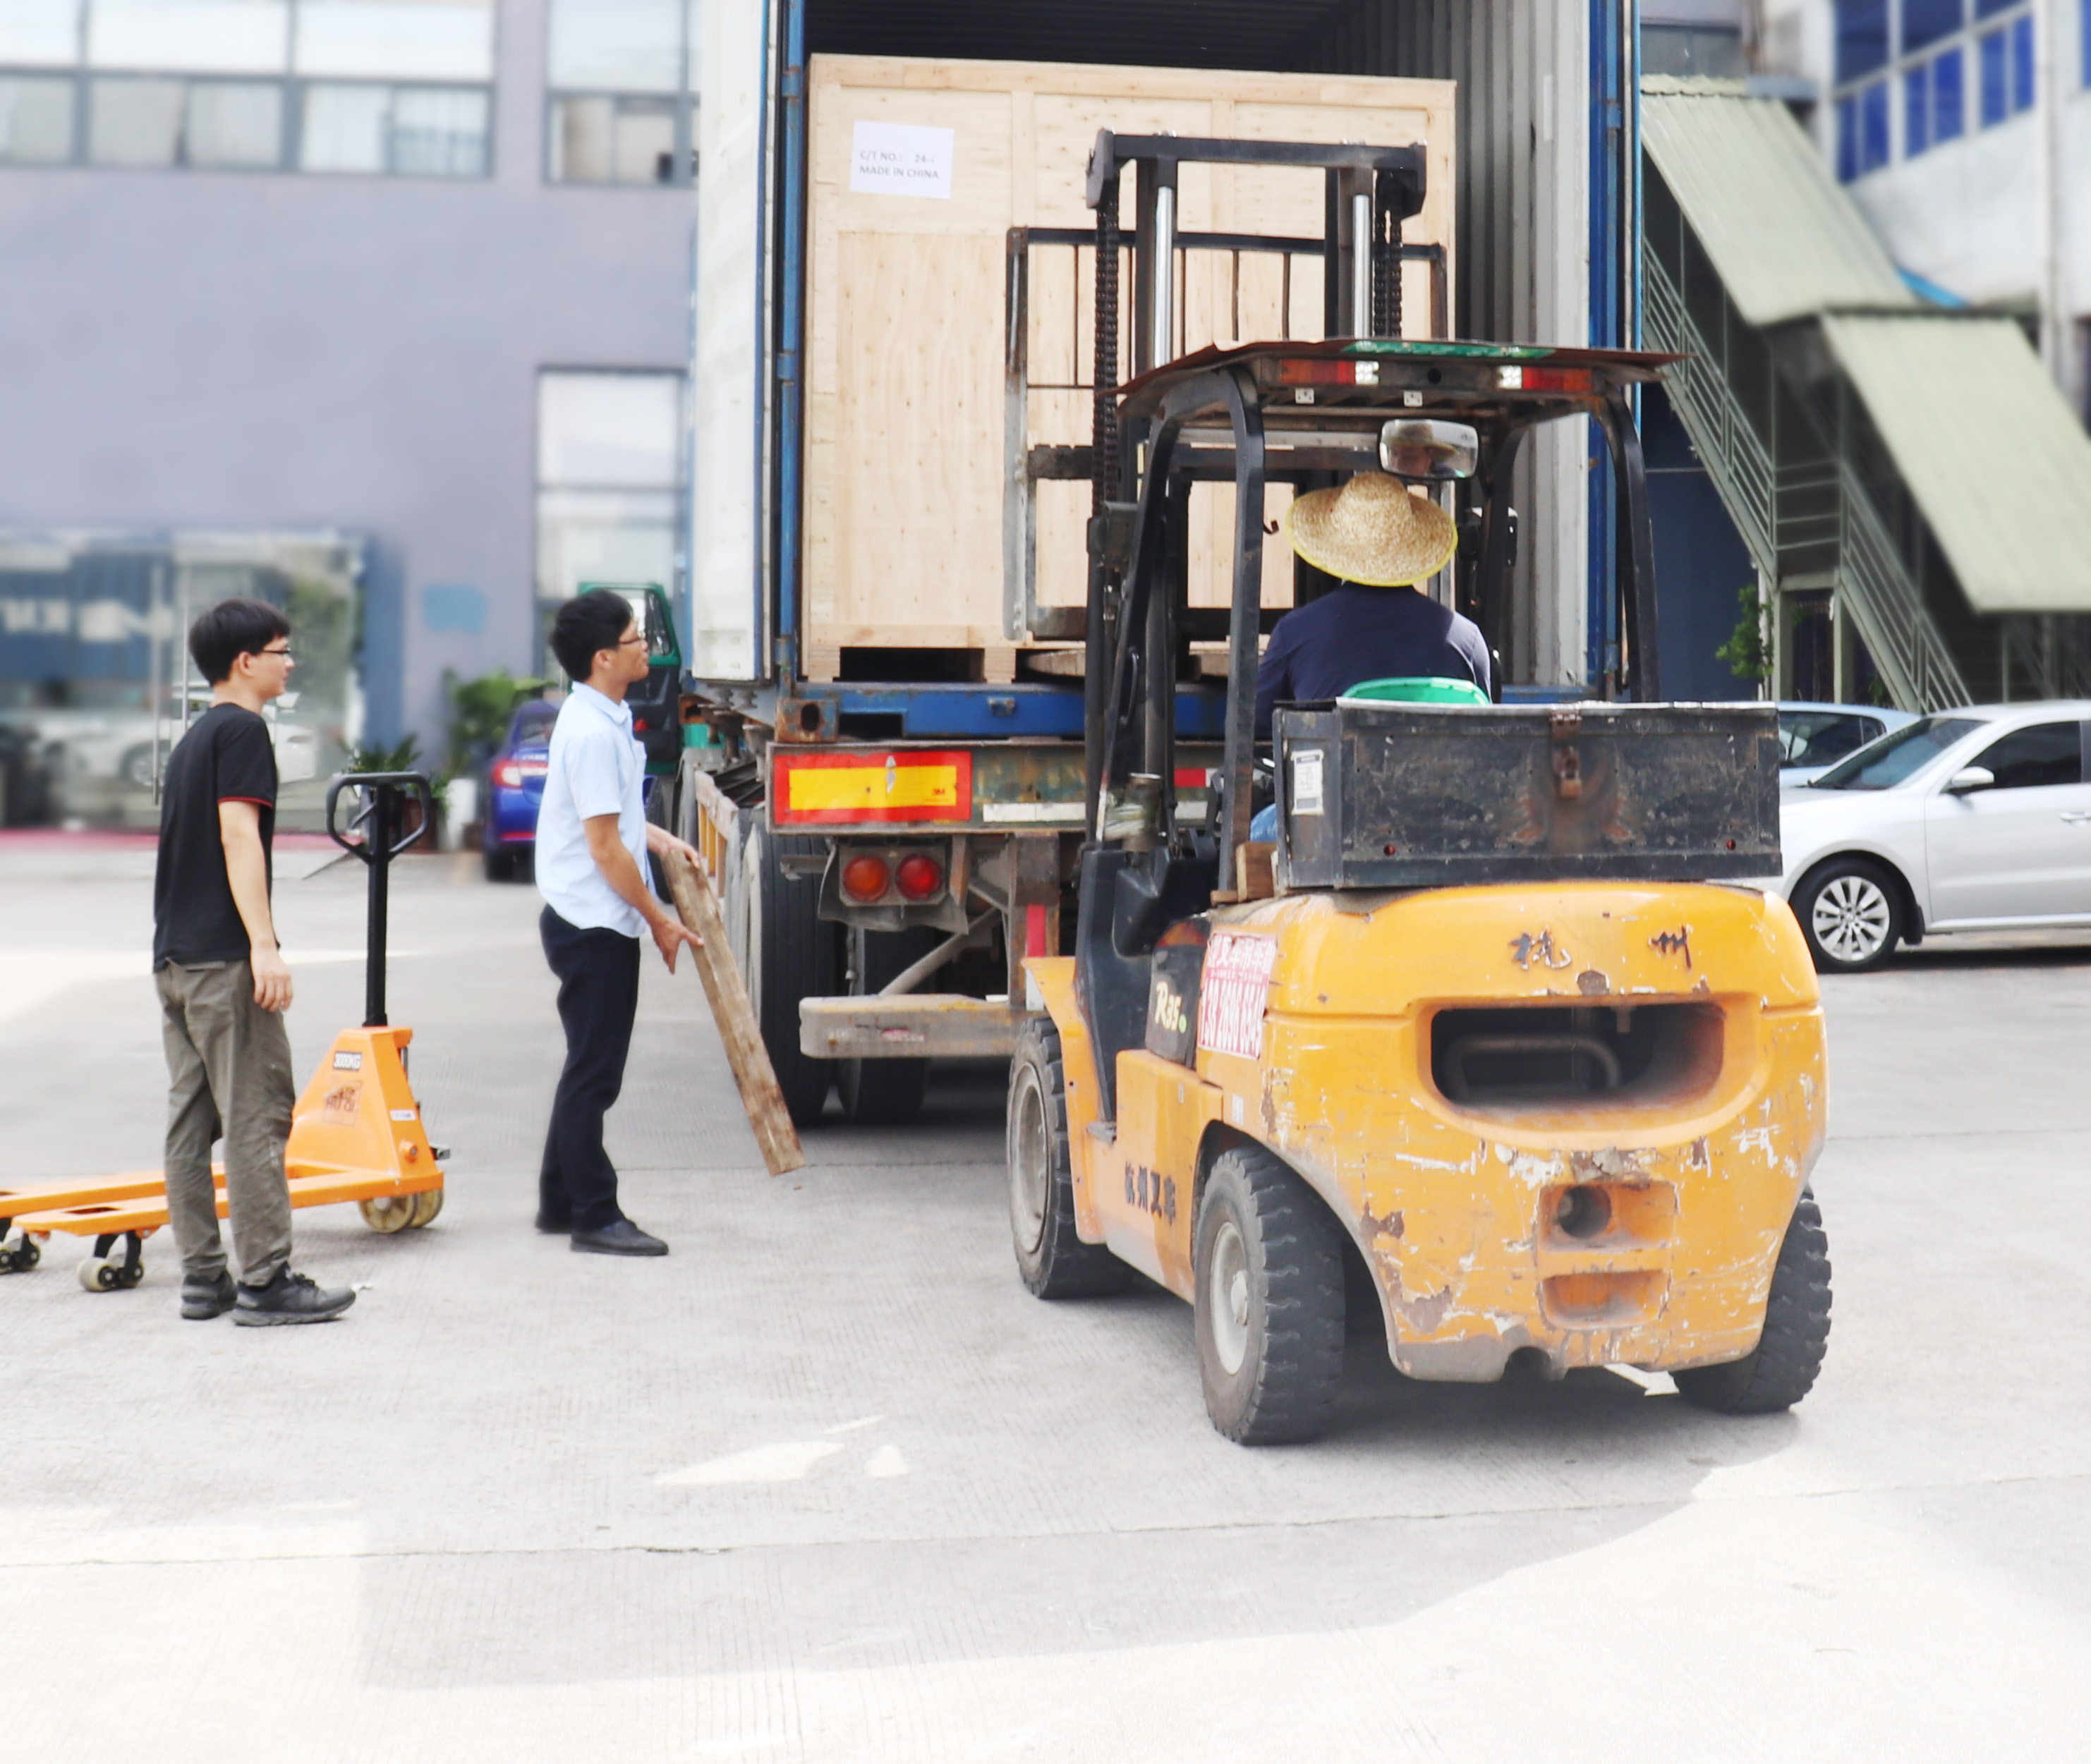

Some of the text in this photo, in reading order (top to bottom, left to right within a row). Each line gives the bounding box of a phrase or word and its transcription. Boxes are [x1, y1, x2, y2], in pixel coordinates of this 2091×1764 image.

[860, 150, 878, 161] C/T
[859, 165, 939, 179] MADE IN CHINA
[1201, 979, 1220, 1047] 138
[334, 1054, 360, 1069] 3000KG
